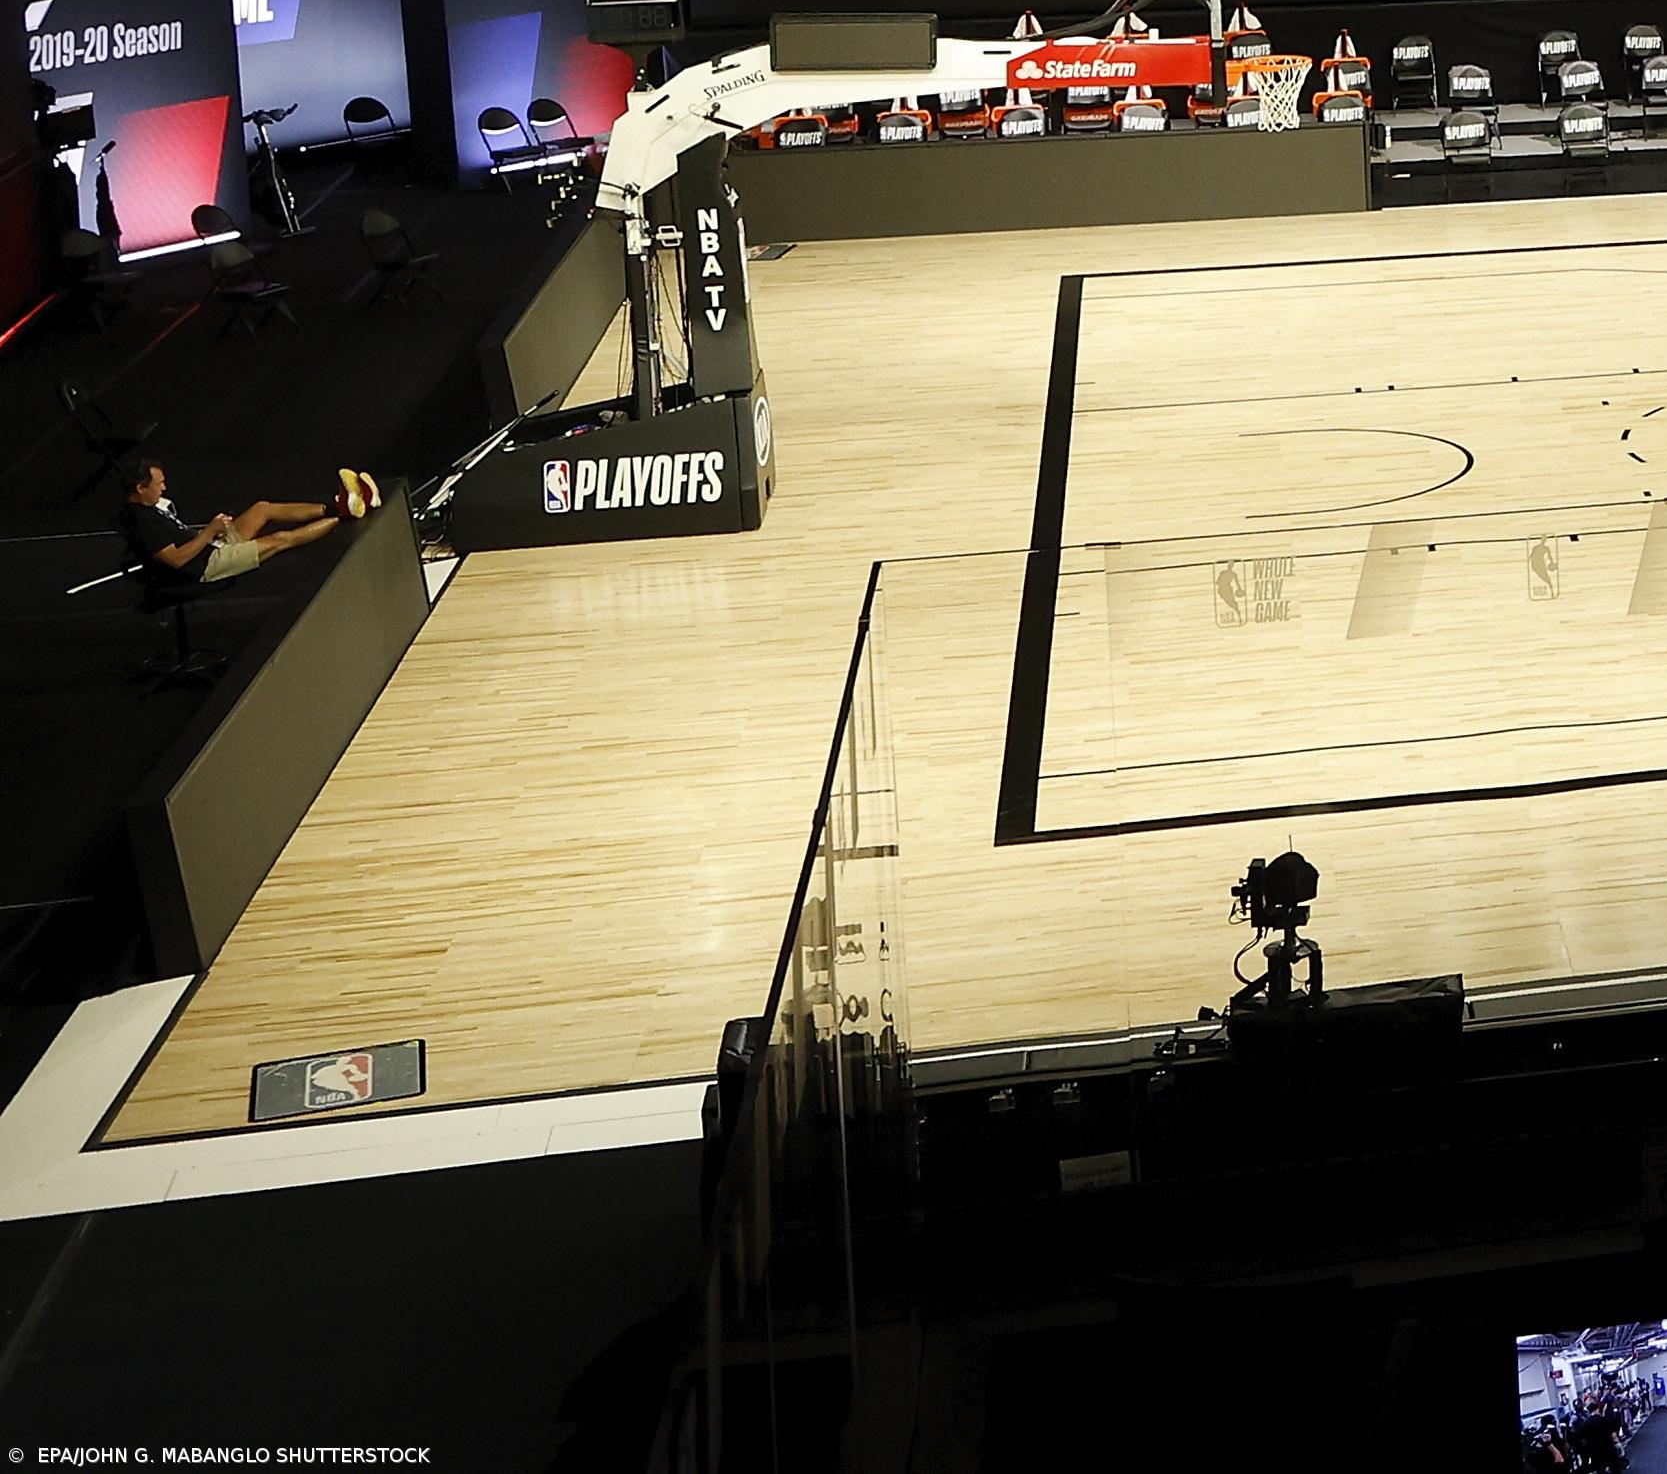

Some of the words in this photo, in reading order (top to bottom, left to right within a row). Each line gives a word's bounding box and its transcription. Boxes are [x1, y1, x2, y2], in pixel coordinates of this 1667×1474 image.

[29, 26, 109, 73] 2019-20
[112, 21, 182, 59] Season
[703, 70, 766, 101] SPALDING
[787, 131, 822, 146] PLAYOFFS
[697, 208, 724, 278] NBA
[704, 285, 727, 332] TV
[574, 451, 724, 511] PLAYOFFS
[1253, 557, 1295, 579] WHOLE
[1254, 578, 1284, 601] NEW
[1255, 600, 1291, 623] GAME
